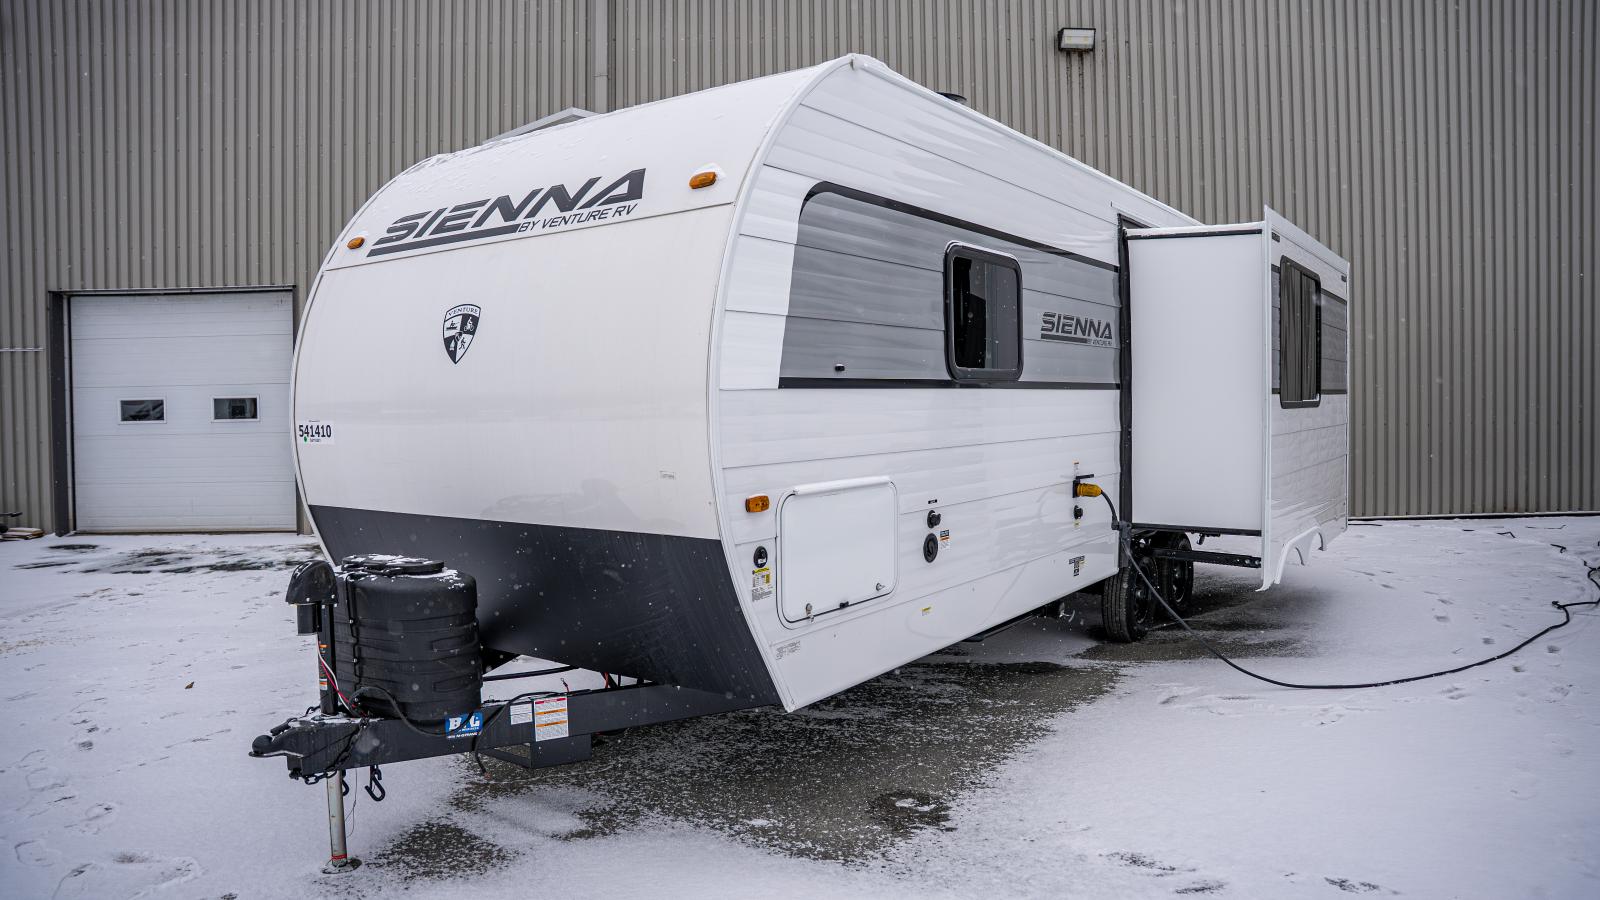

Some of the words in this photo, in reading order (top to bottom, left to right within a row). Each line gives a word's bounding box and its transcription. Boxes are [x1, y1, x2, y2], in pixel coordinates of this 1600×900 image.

[372, 168, 647, 246] SIENNA
[518, 220, 540, 233] BY
[542, 208, 612, 229] VENTURE
[612, 203, 639, 218] RV
[448, 306, 479, 316] VENTURE
[1041, 312, 1113, 339] SIENNA
[298, 424, 332, 438] 541410
